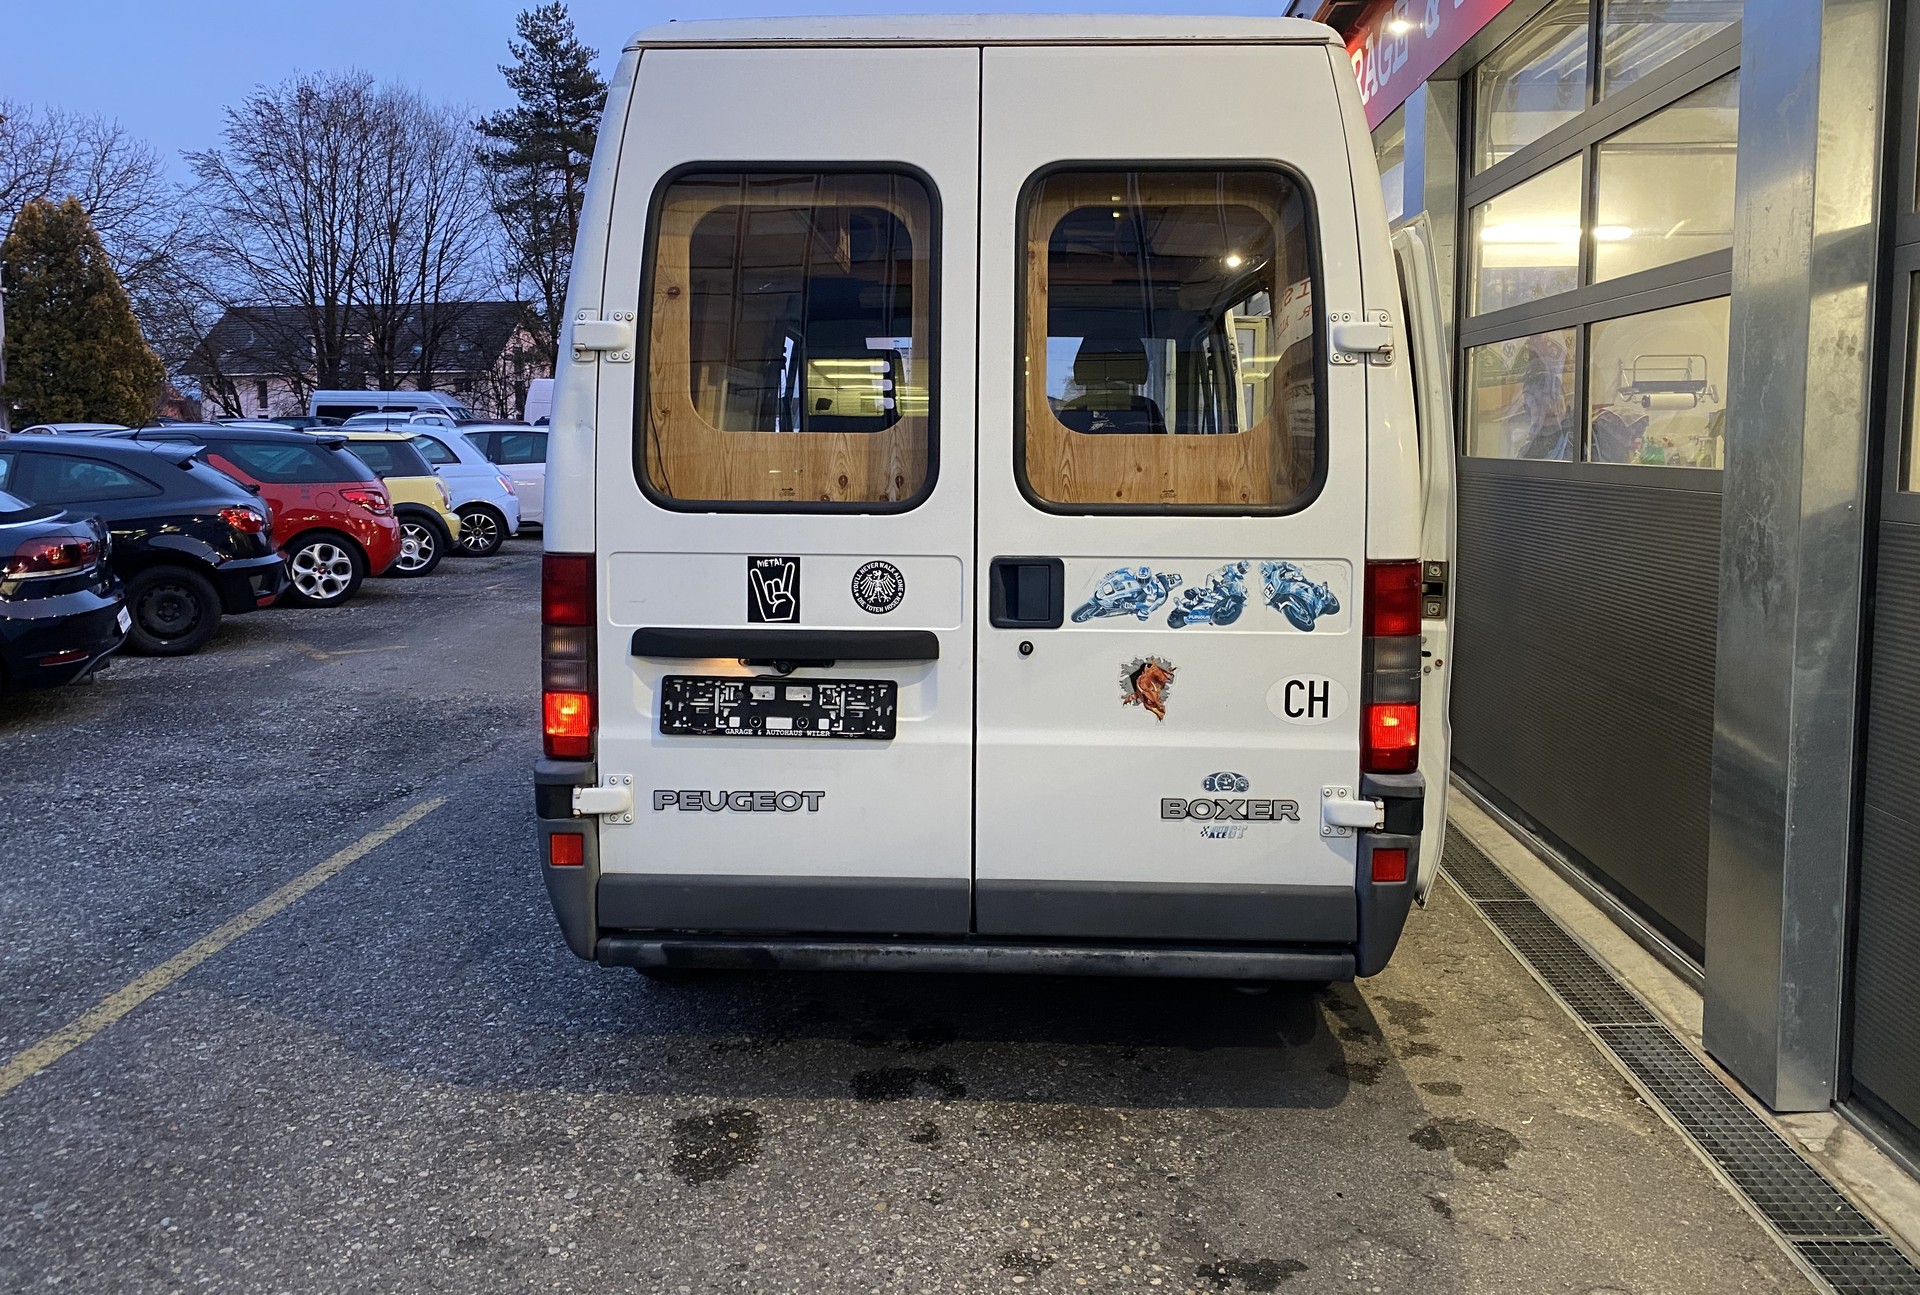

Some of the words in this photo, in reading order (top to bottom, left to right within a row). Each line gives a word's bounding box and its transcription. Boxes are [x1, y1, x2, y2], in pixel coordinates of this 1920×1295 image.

[757, 558, 785, 568] METAL
[859, 562, 879, 575] NEVER
[879, 562, 896, 574] WALK
[893, 572, 904, 592] ALONE
[857, 596, 867, 608] DIE
[865, 604, 884, 613] TOTEN
[884, 596, 901, 611] HOSEN
[1284, 679, 1329, 718] CH
[653, 789, 826, 812] PEUGEOT
[1160, 797, 1301, 821] BOXER
